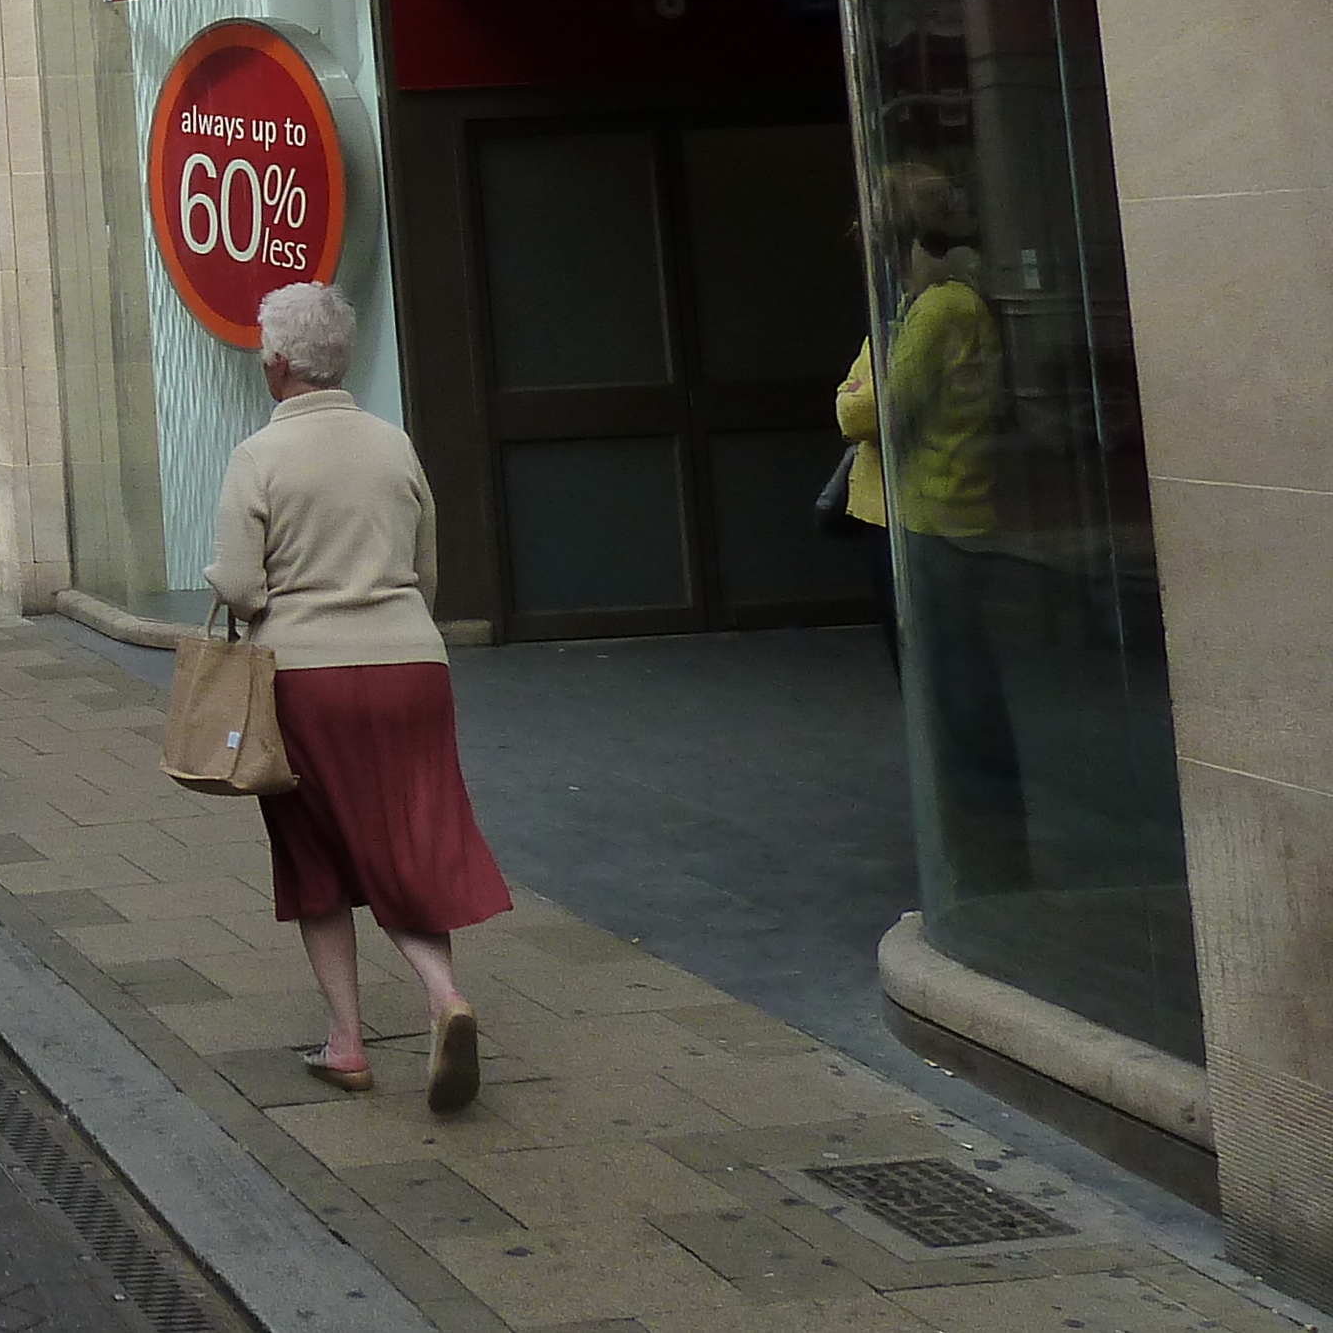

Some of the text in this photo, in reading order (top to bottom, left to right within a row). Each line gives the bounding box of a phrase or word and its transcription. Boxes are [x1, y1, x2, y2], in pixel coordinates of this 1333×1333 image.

[181, 104, 307, 151] always up to
[180, 153, 307, 263] 60%
[261, 227, 307, 271] less
